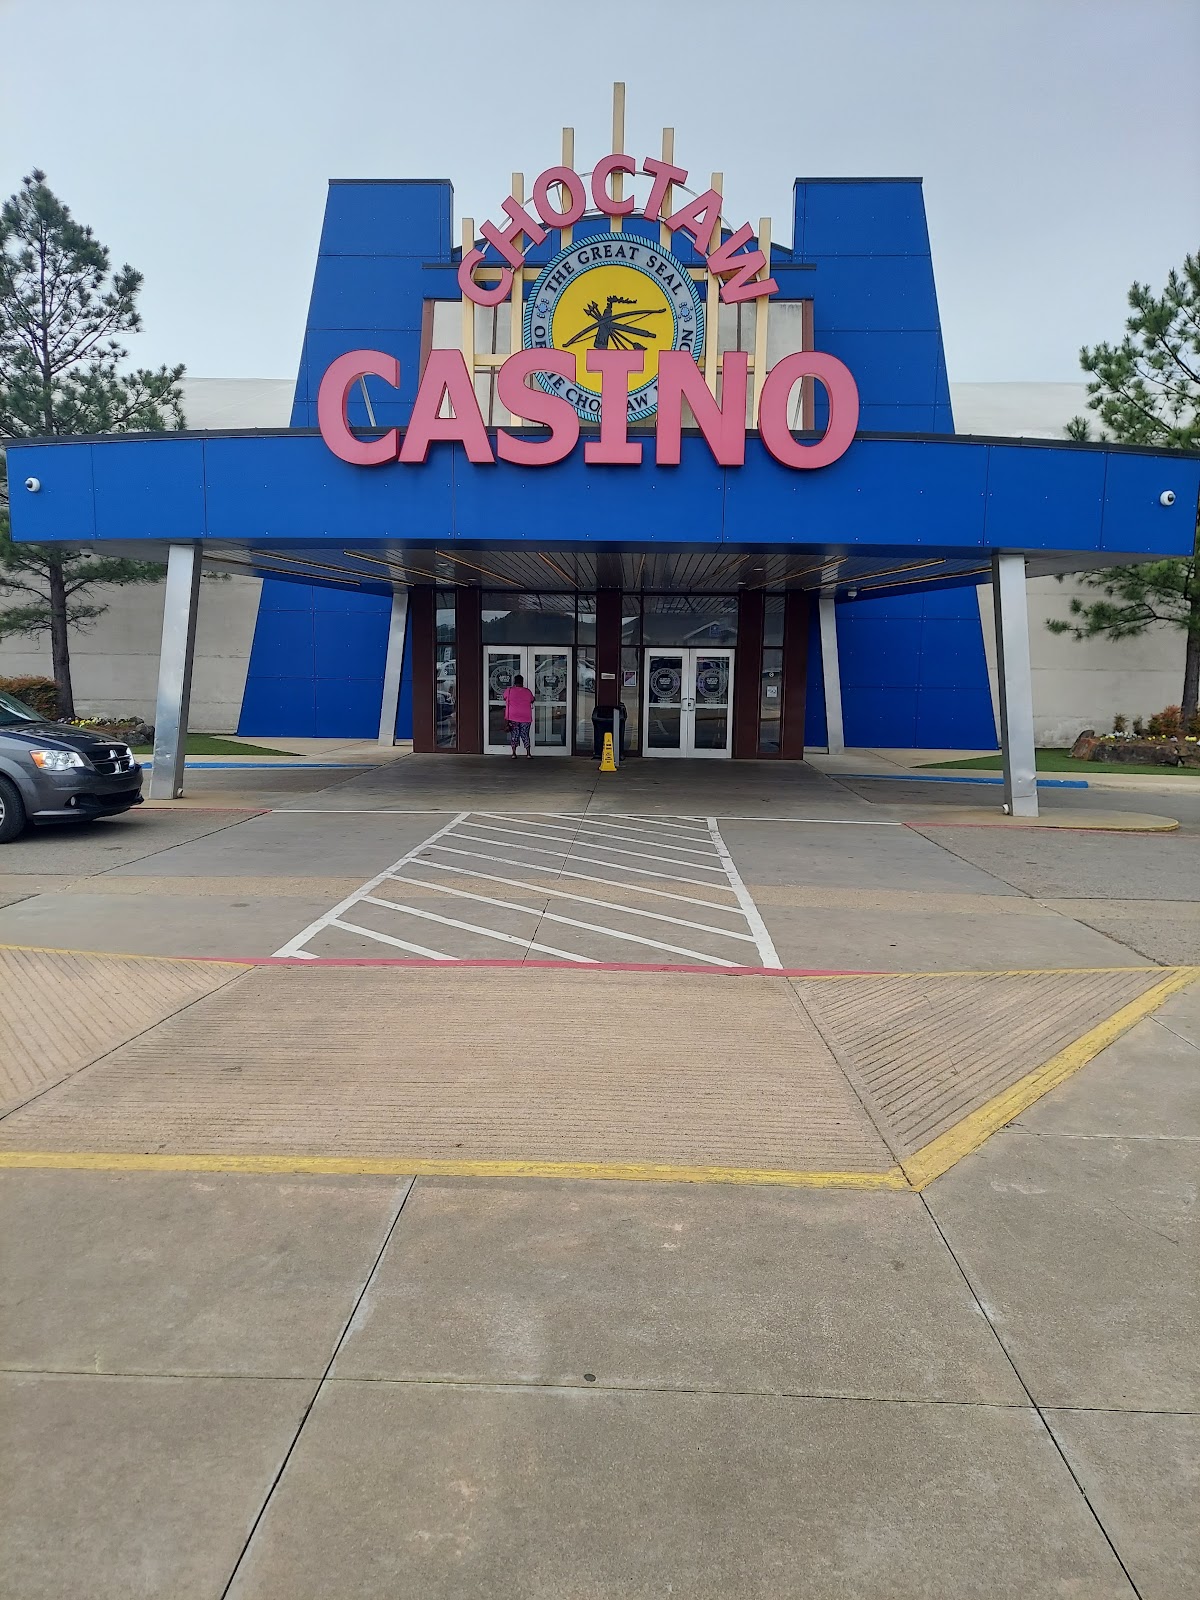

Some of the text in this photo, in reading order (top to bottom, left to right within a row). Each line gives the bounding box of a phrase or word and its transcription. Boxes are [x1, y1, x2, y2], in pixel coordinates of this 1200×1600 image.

[457, 153, 780, 308] CHOCTAW
[544, 244, 683, 296] THE GREAT SEAL
[317, 347, 860, 470] CASINO
[565, 388, 648, 413] CHOAW
